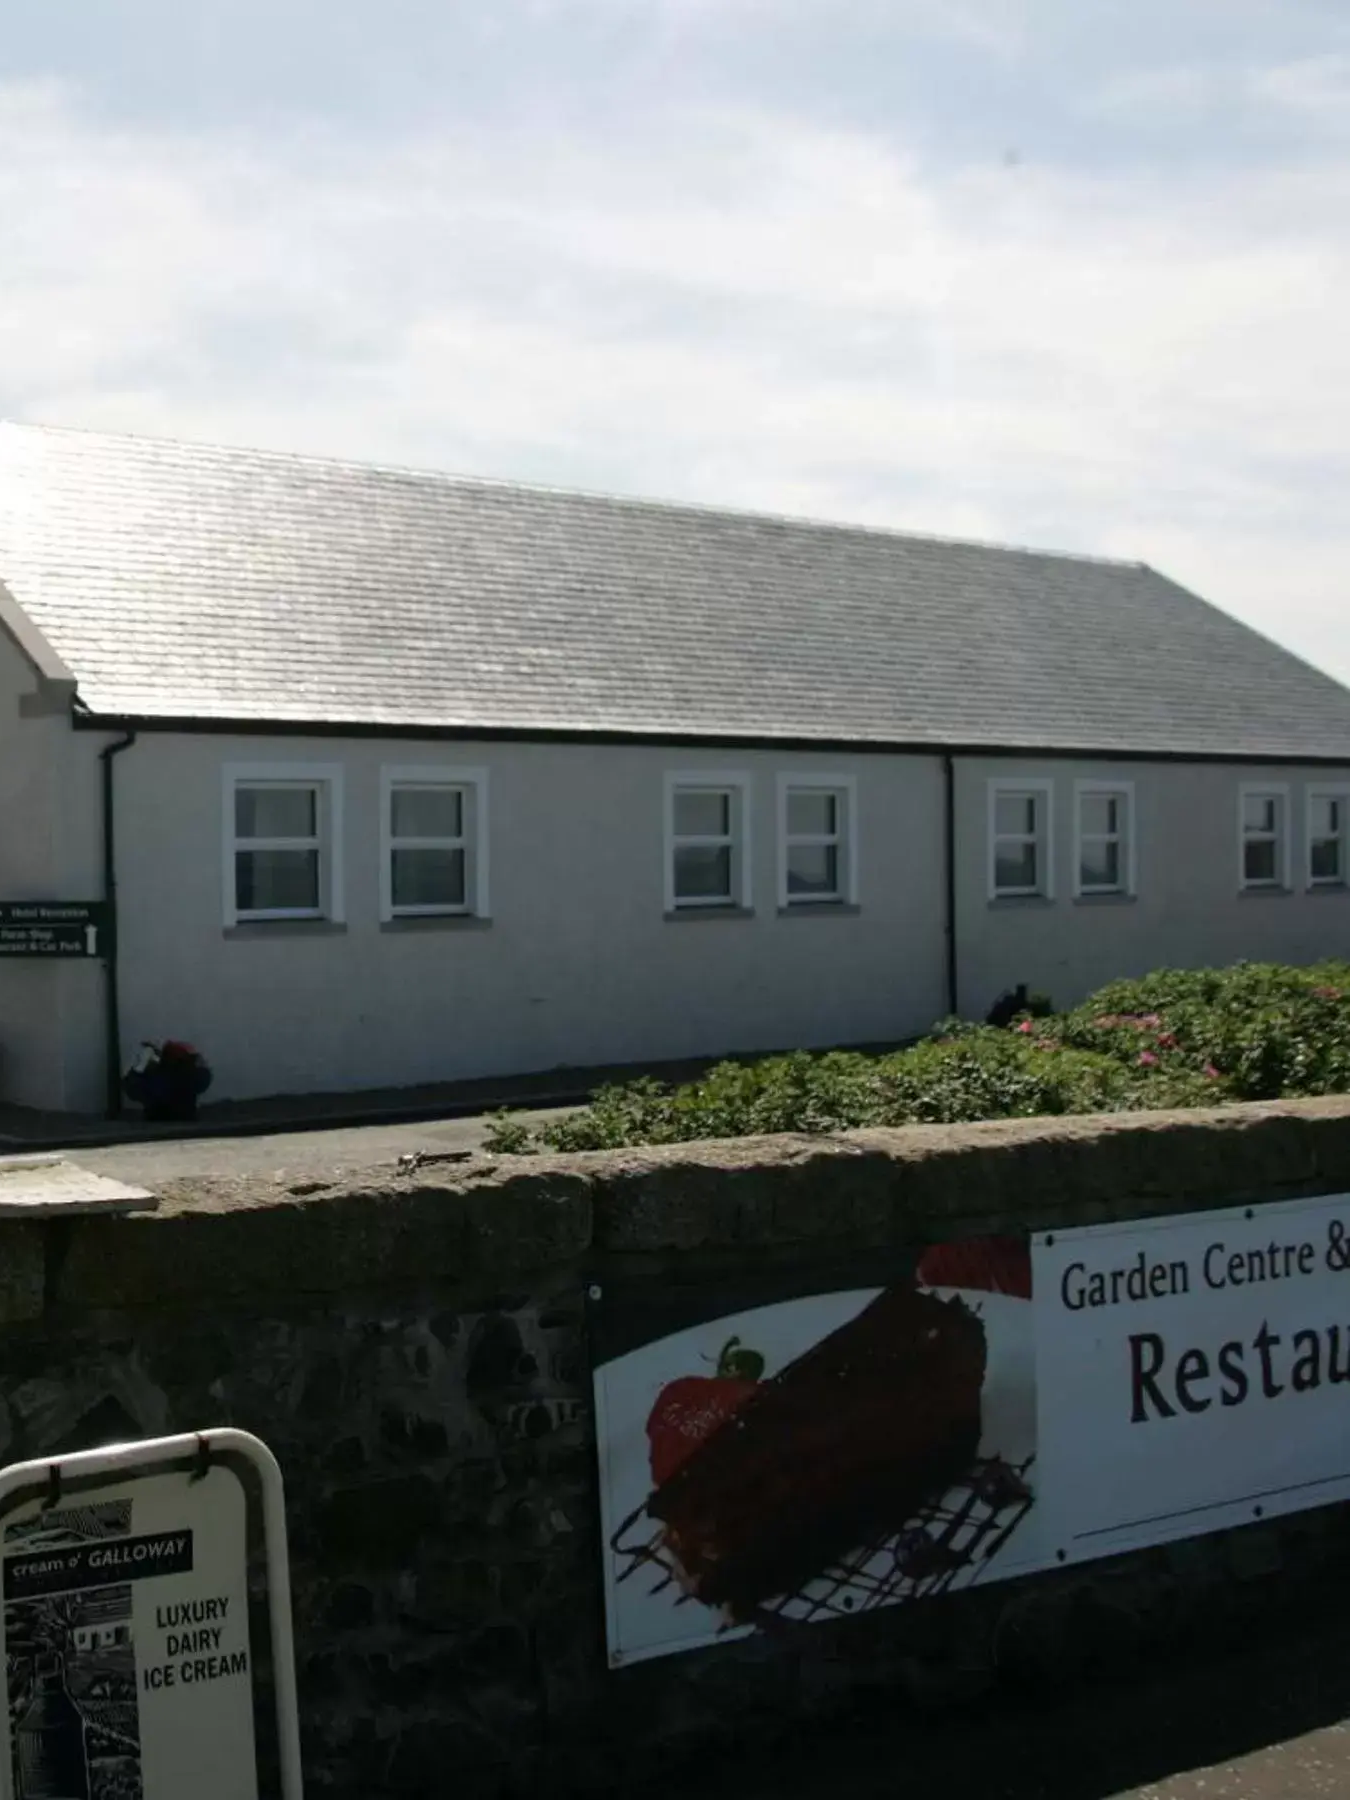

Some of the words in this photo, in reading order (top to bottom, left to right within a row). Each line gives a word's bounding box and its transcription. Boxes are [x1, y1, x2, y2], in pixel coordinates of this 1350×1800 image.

[1061, 1252, 1190, 1310] Garden
[1203, 1241, 1314, 1289] Centre
[1325, 1219, 1350, 1272] &
[12, 1559, 63, 1577] cream
[88, 1538, 186, 1568] GALLOWAY
[156, 1597, 229, 1628] LUXURY
[166, 1628, 222, 1656] DAIRY
[144, 1667, 174, 1690] ICE
[181, 1652, 247, 1683] CREAM
